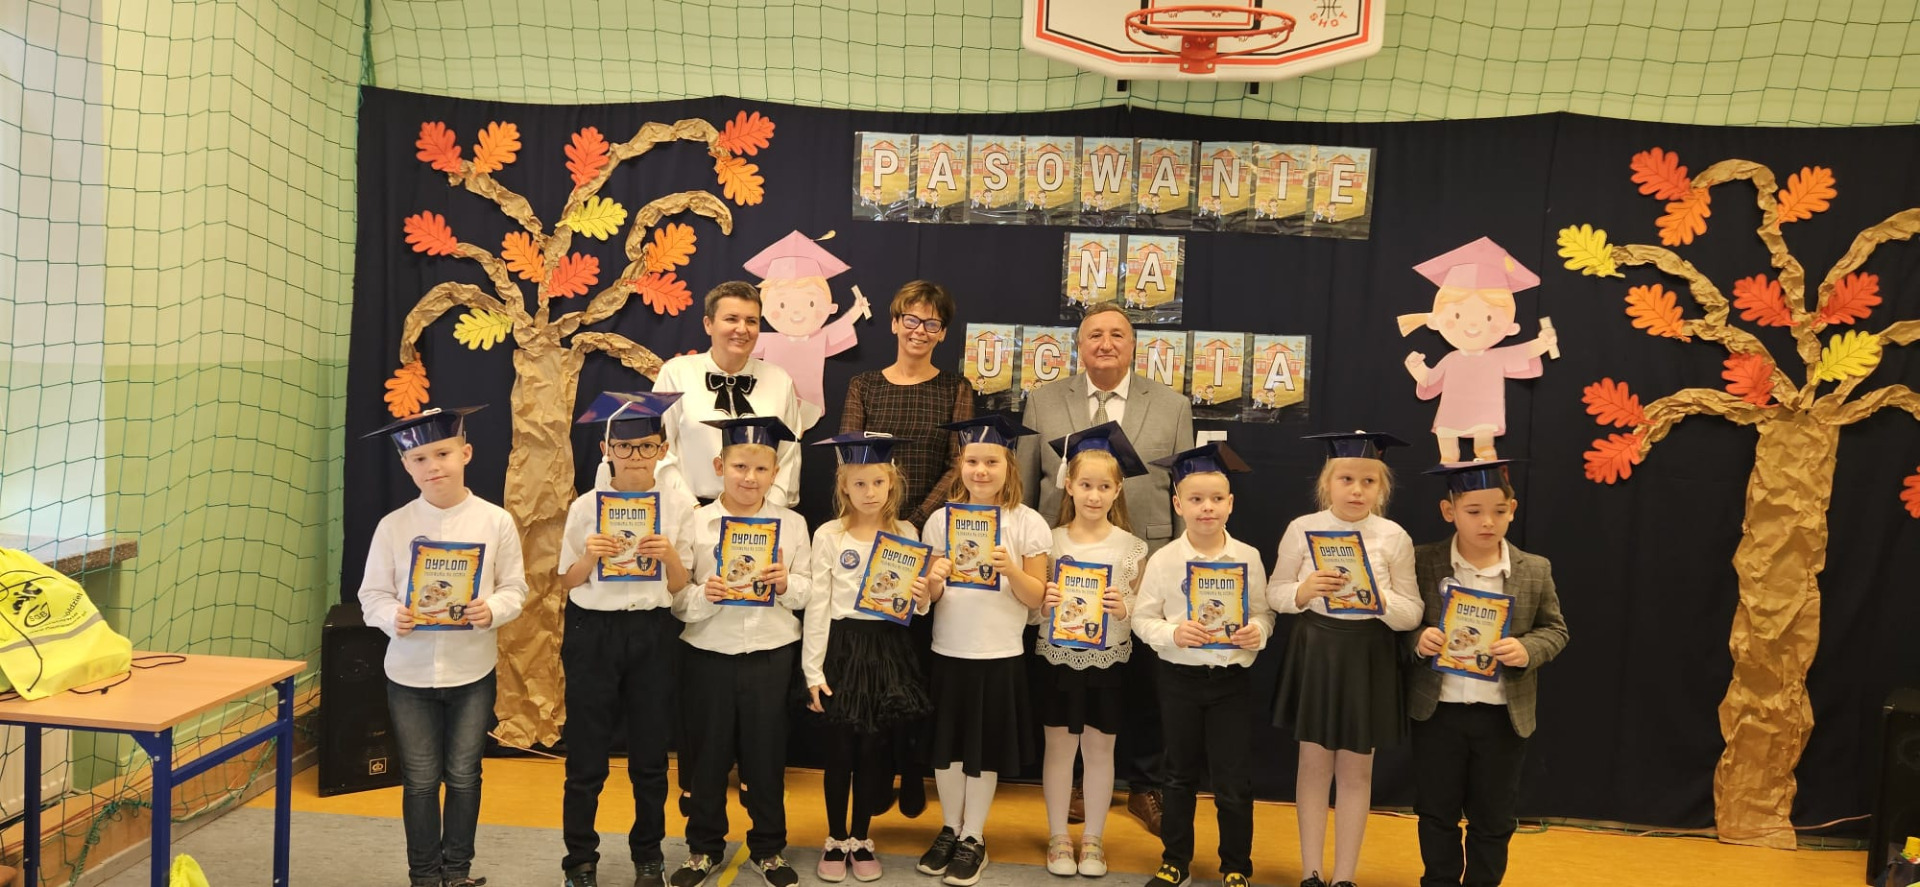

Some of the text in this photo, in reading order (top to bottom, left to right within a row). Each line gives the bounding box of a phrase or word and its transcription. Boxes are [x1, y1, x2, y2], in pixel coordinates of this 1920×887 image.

[1309, 10, 1348, 28] SHOT
[873, 149, 1354, 204] PASOWANIE
[1079, 250, 1166, 292] NA
[977, 339, 1295, 391] UCNIA
[609, 508, 646, 520] DYPLOM
[956, 519, 989, 531] DYPLOM
[731, 533, 767, 545] DYPLOM
[881, 548, 917, 567] DYPLOM
[1320, 546, 1355, 557] DYPLOM
[425, 558, 468, 570] DYPLOM
[1065, 575, 1099, 590] DYPLOM
[1198, 578, 1235, 590] DYPLOM
[1456, 603, 1497, 620] DYPLOM
